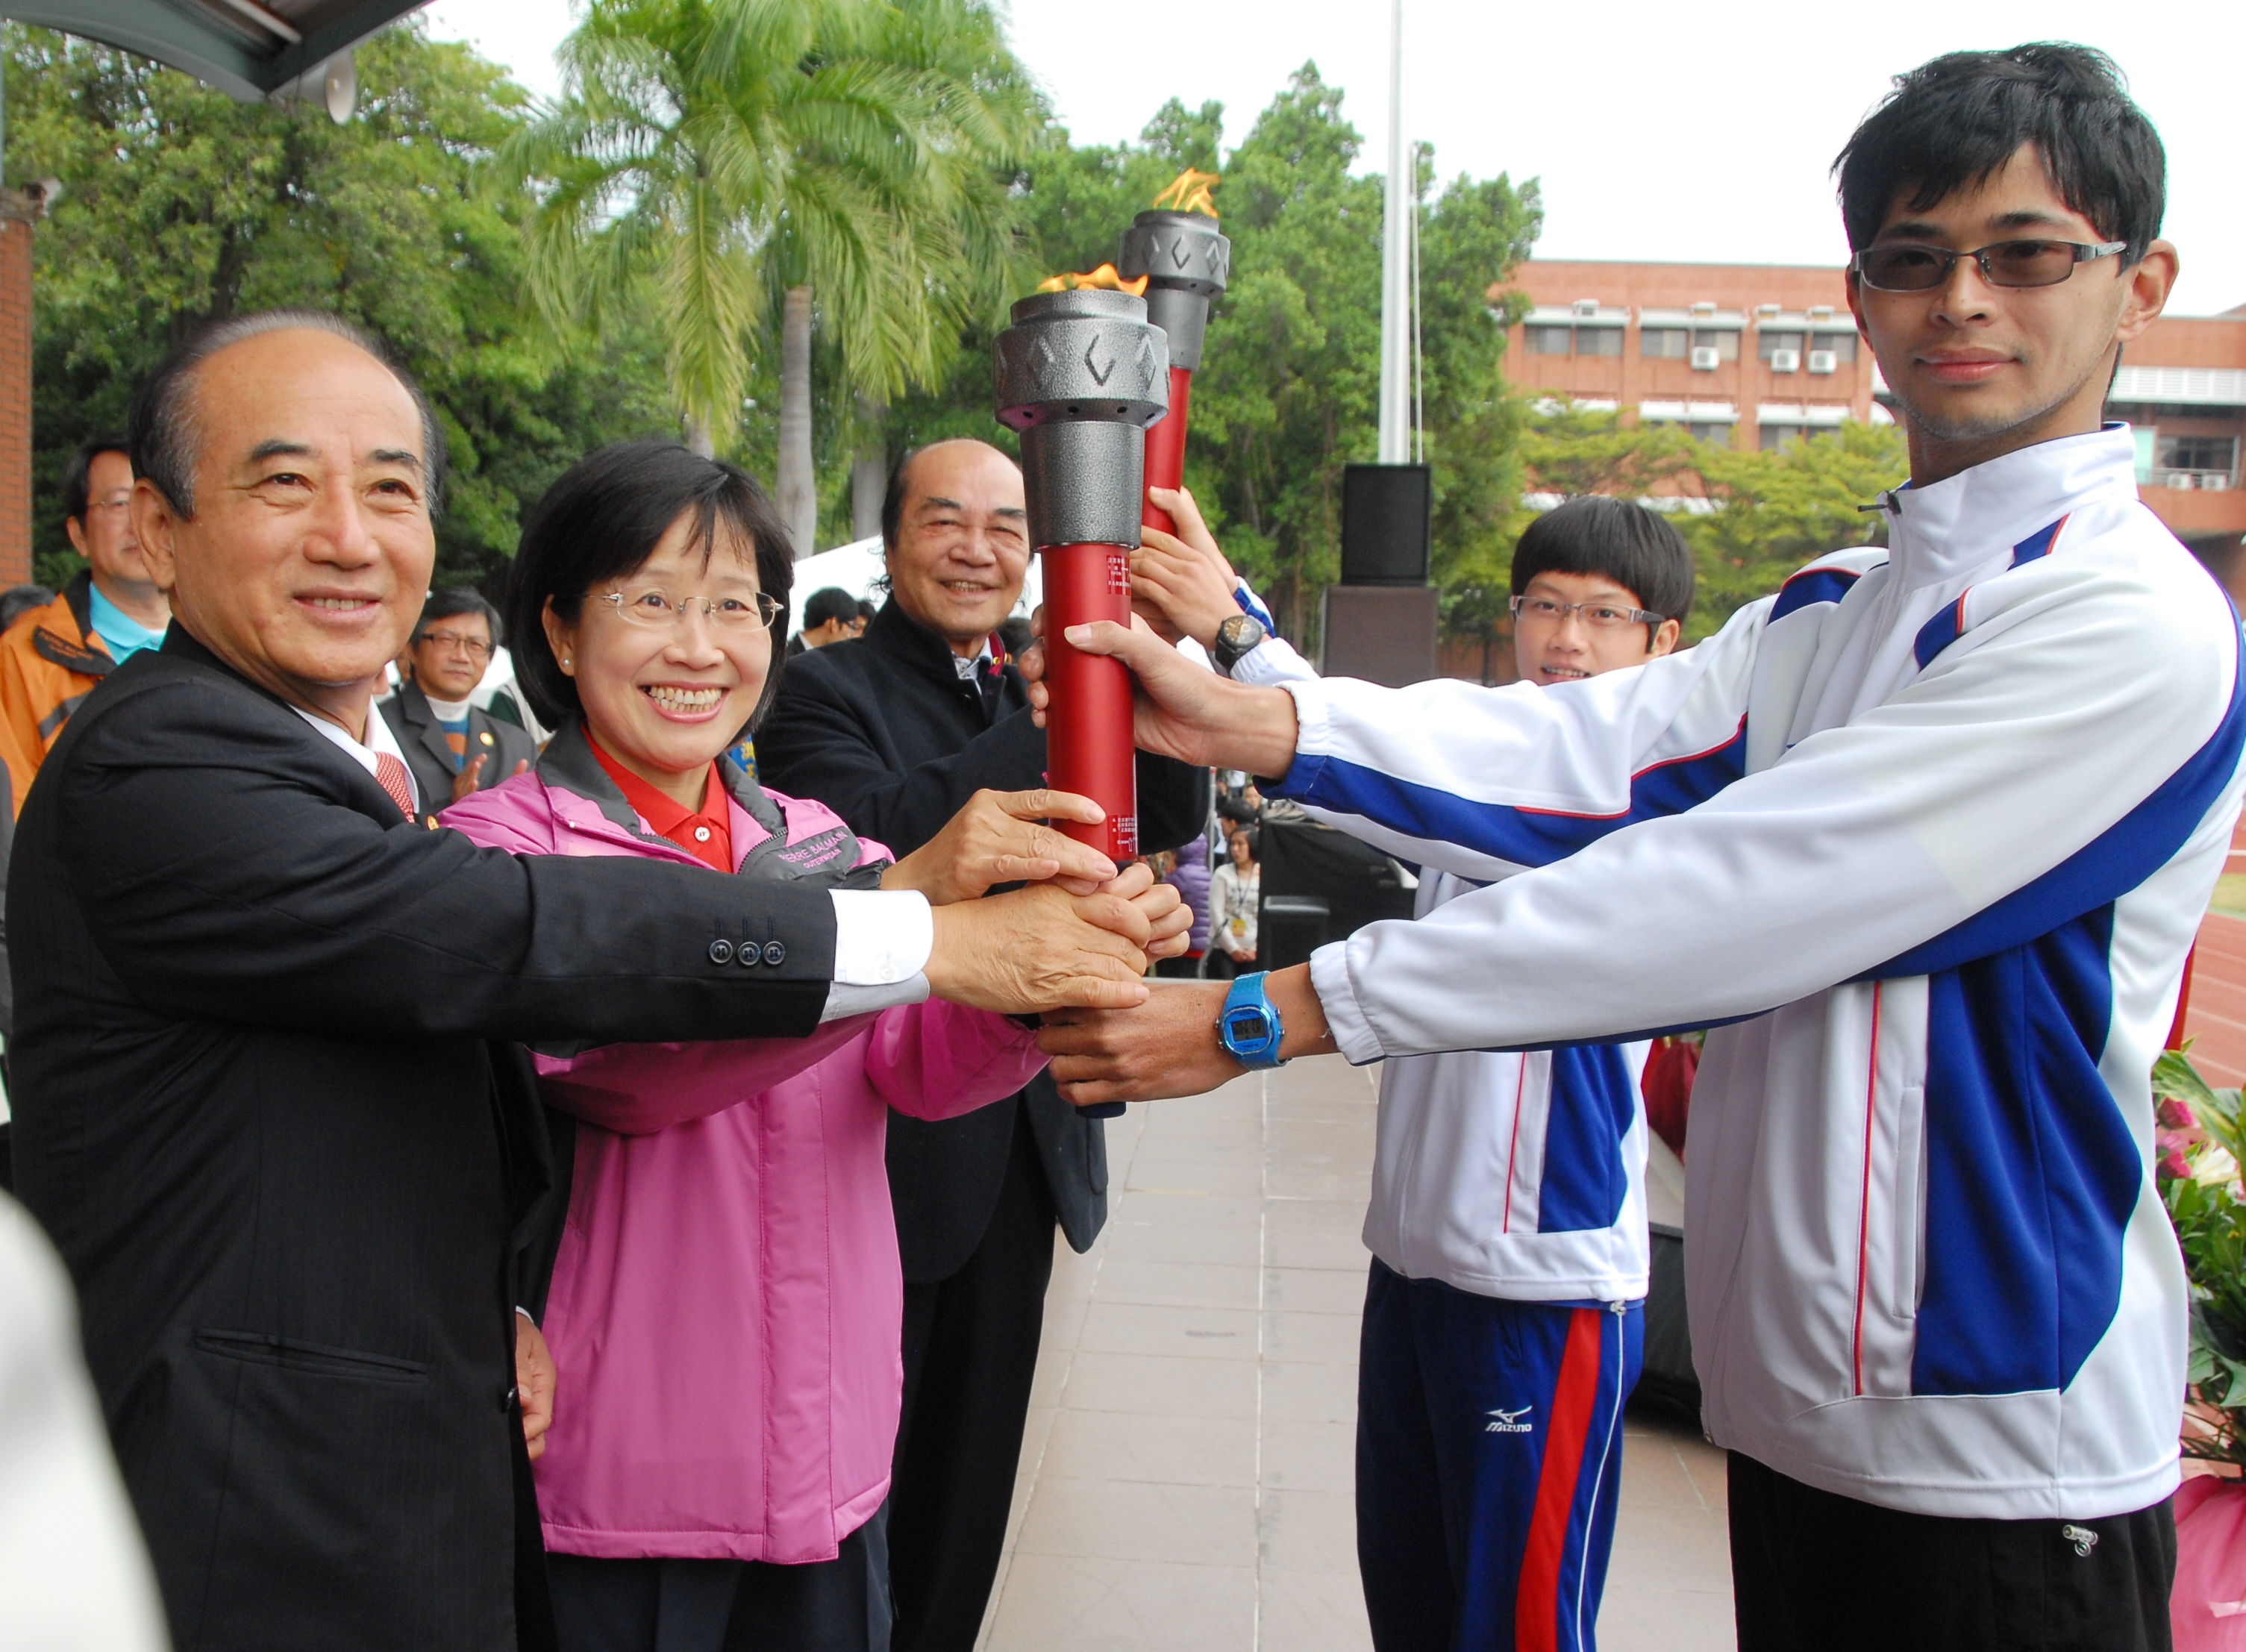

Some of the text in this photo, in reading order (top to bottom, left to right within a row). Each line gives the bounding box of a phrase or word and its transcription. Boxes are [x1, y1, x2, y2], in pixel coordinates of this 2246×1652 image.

[810, 831, 848, 854] BALMAIN
[804, 848, 842, 869] OUTERWEAR
[1485, 1421, 1532, 1432] MIZUNO
